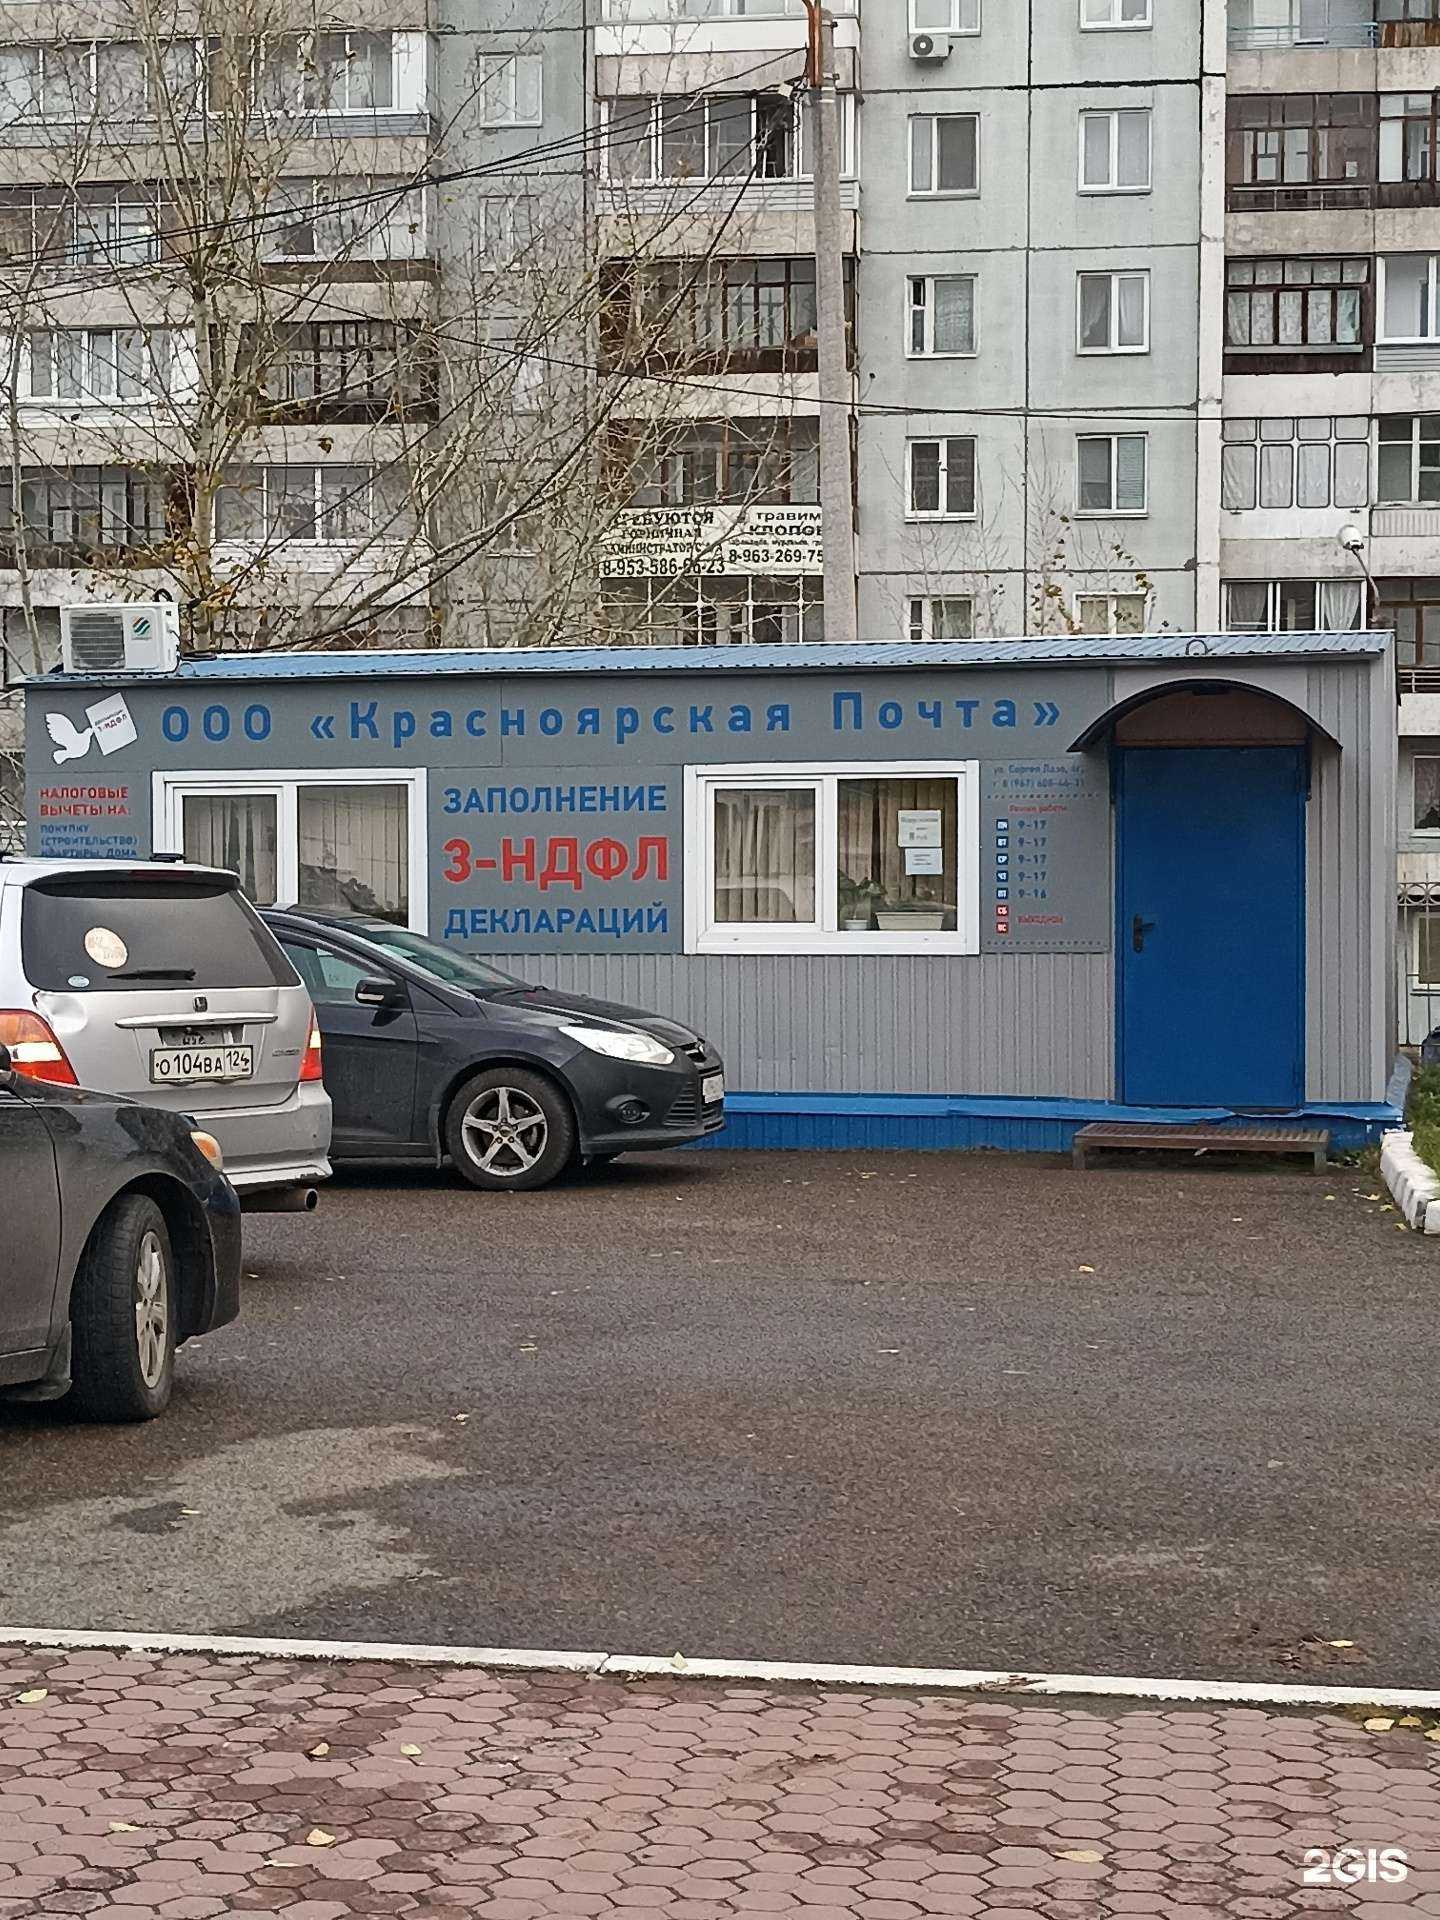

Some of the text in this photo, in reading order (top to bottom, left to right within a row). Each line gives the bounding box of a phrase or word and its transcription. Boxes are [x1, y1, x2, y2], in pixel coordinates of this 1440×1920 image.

[161, 704, 272, 743] ООО
[310, 700, 790, 749] «Красноярская
[832, 691, 1061, 731] Почта»
[40, 786, 129, 799] НАЛОГОВЫЕ
[443, 784, 667, 815] ЗАПОЛНЕНИЕ
[40, 804, 102, 817] ВЫЧЕТЫ
[40, 823, 89, 834] ПОКУПКУ
[41, 835, 138, 847] (СТРОИТЕЛЬСТВО)
[443, 836, 668, 891] 3-НДФЛ
[1017, 854, 1047, 864] 9-17
[1017, 871, 1047, 881] 9-17
[444, 901, 668, 939] ДЕКЛАРАЦИЙ
